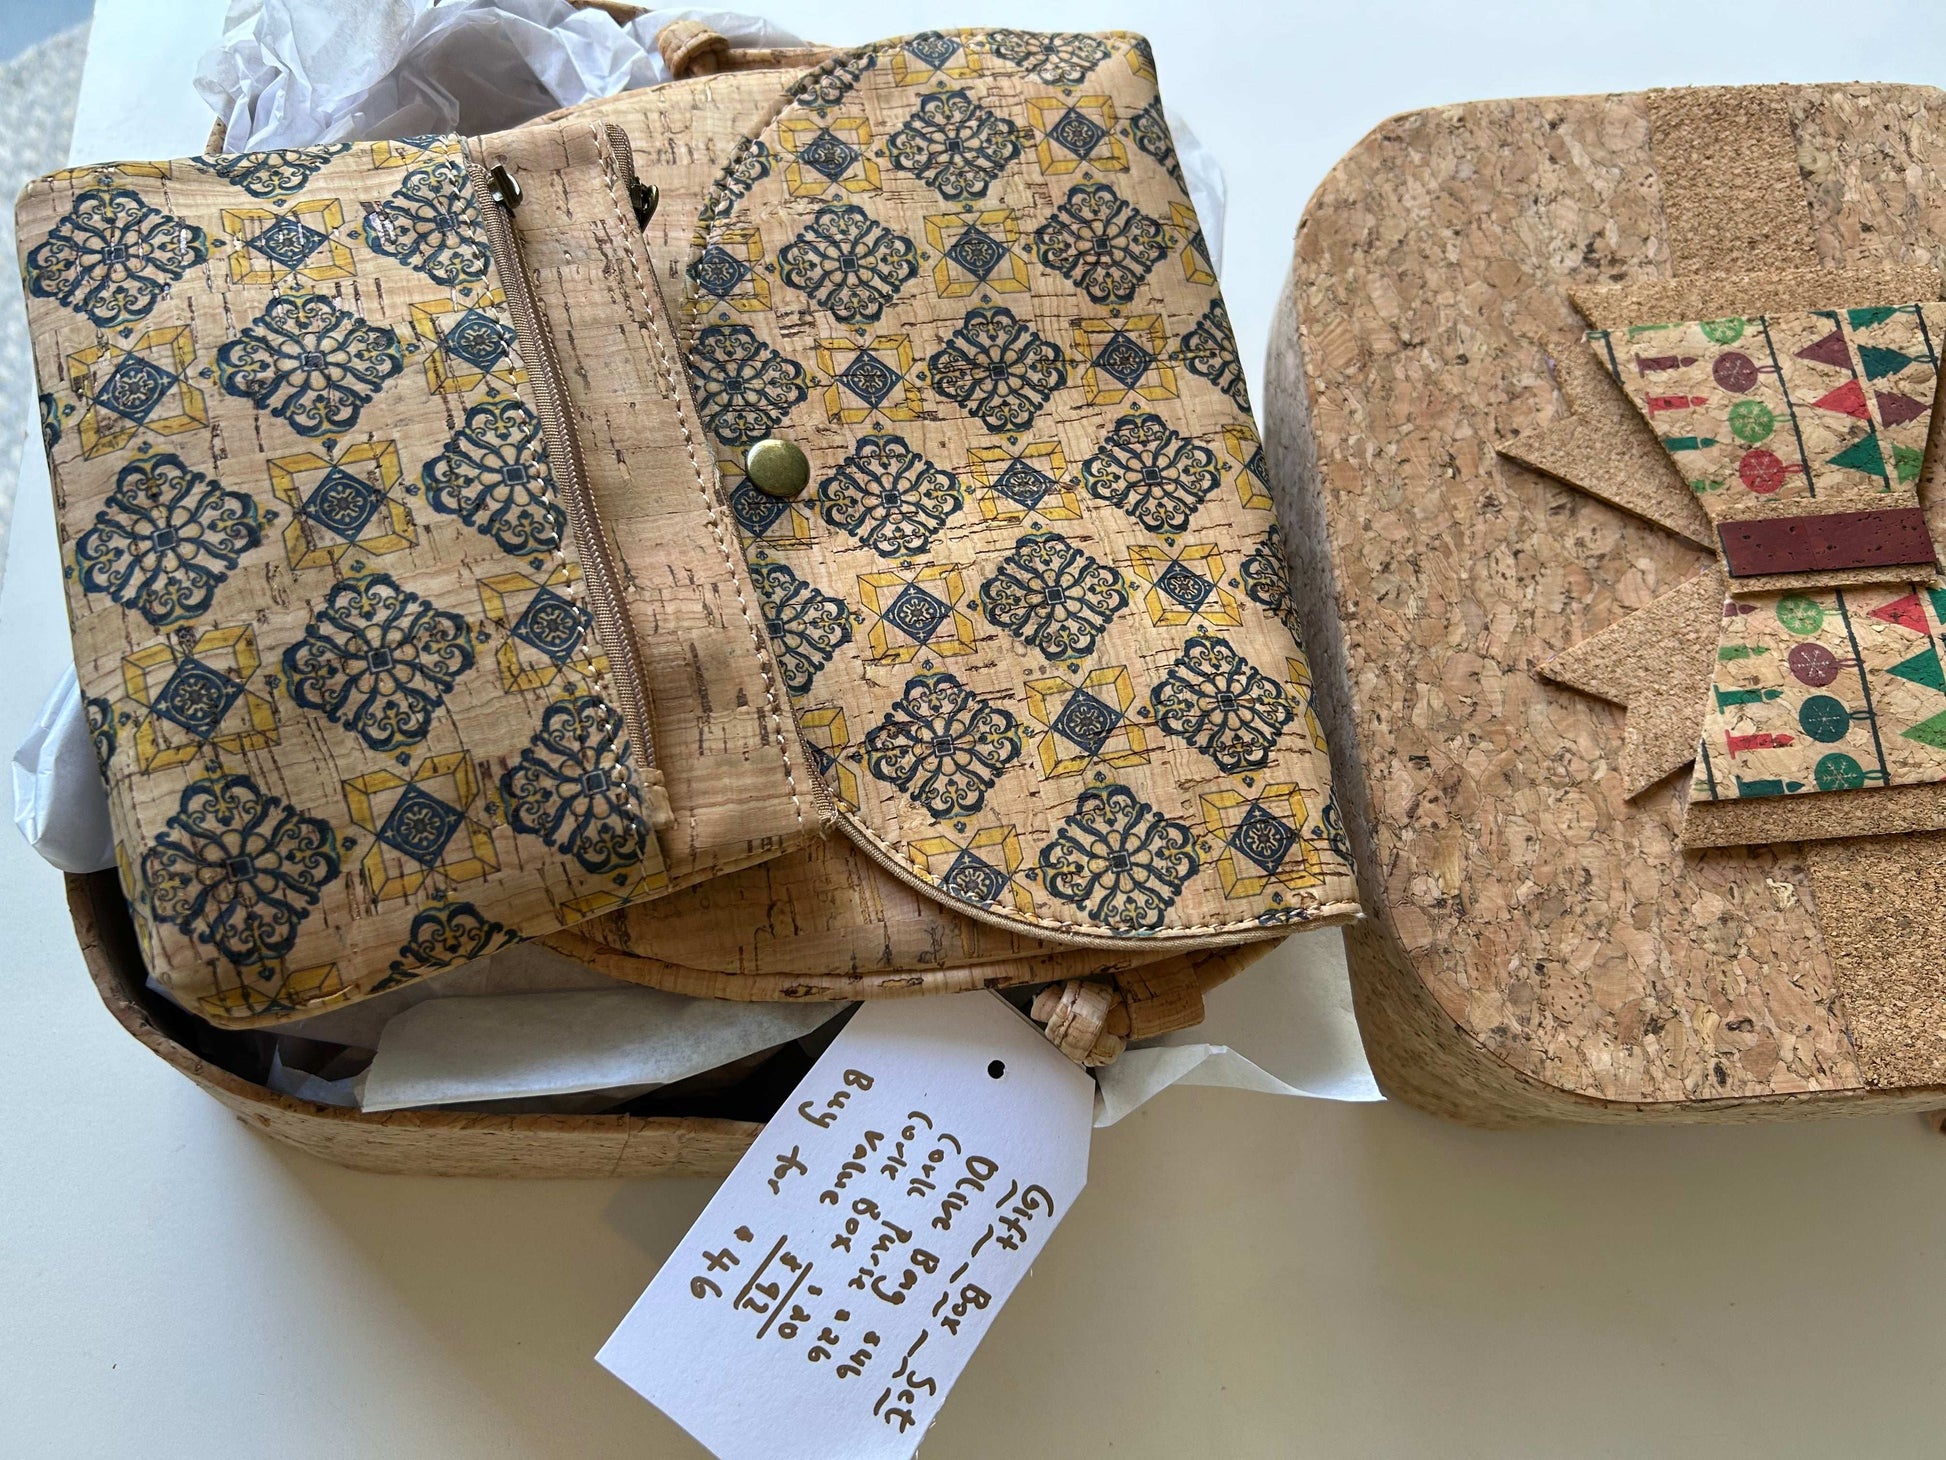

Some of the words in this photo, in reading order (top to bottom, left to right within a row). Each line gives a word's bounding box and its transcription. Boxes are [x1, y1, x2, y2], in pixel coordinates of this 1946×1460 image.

[796, 1067, 876, 1130] Buy
[766, 1143, 809, 1197] for
[879, 1109, 935, 1182] Cork
[905, 1132, 963, 1199] Cork
[829, 1196, 883, 1255] Box
[994, 1183, 1056, 1252] Gift
[846, 1219, 914, 1292] Purse
[869, 1247, 942, 1307] Bag
[939, 1281, 993, 1337] Box
[883, 1369, 938, 1435] Set
